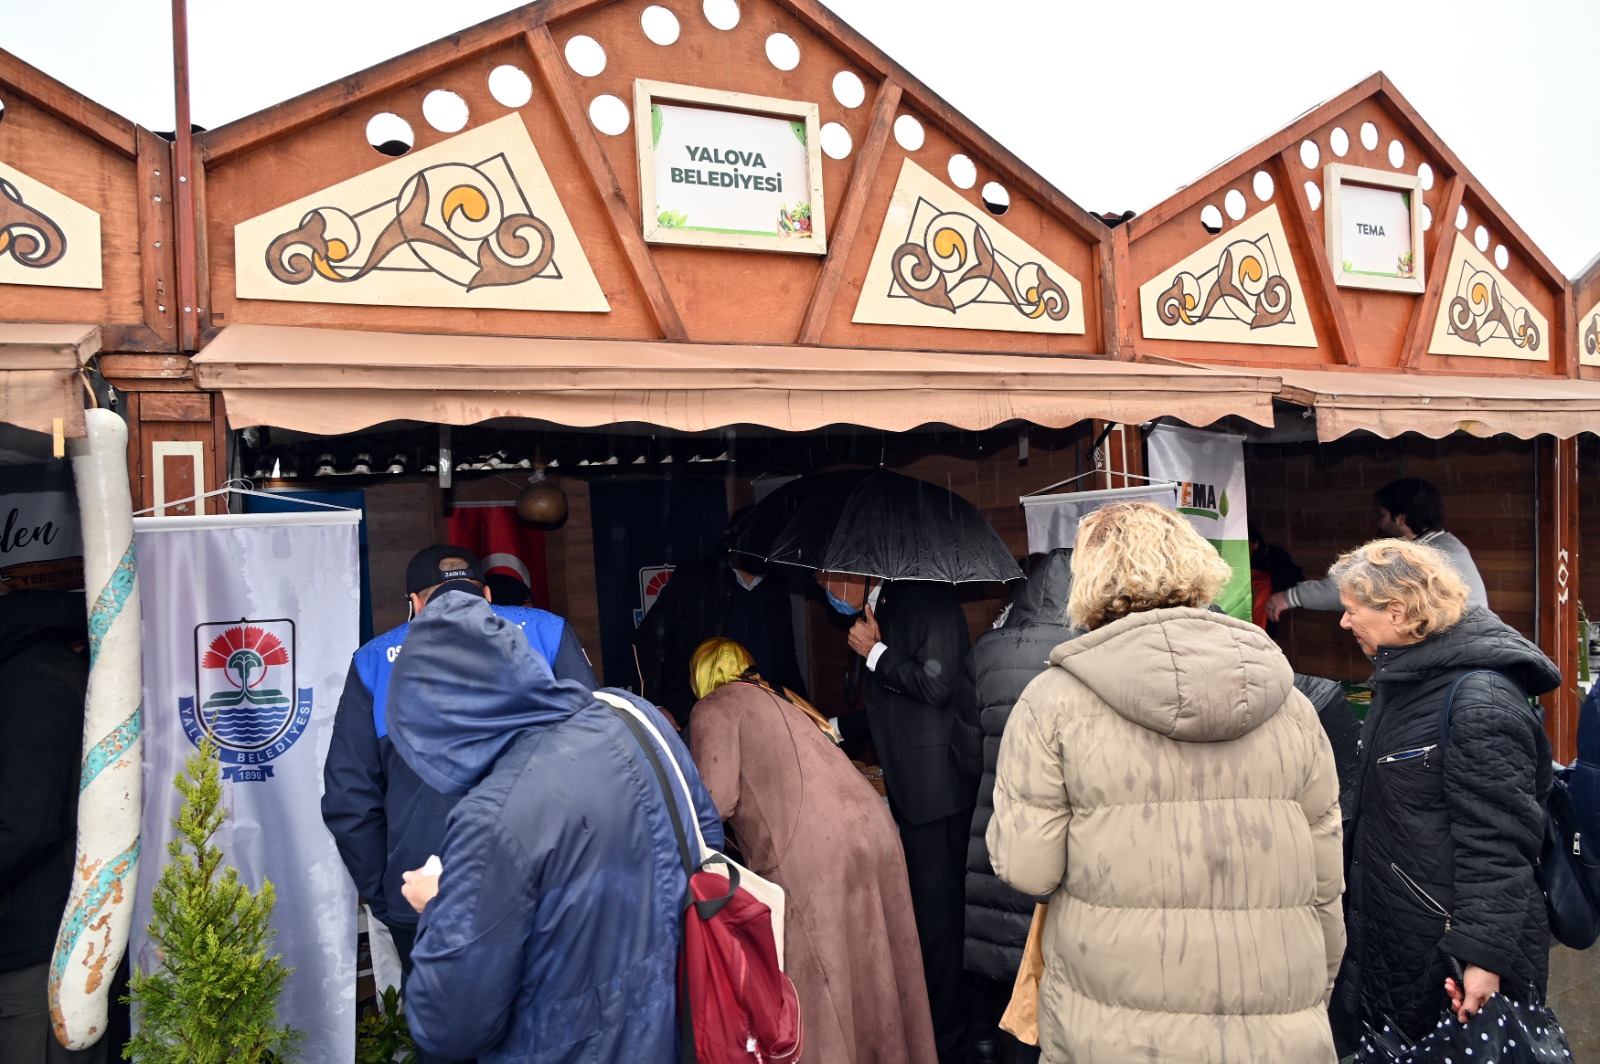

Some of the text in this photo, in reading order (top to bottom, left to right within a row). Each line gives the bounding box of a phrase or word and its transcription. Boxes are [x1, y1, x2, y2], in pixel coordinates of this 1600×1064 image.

[685, 145, 766, 168] YALOVA
[670, 167, 782, 192] BELEDİYESİ
[1356, 223, 1385, 237] TEMA
[238, 770, 263, 780] 1890
